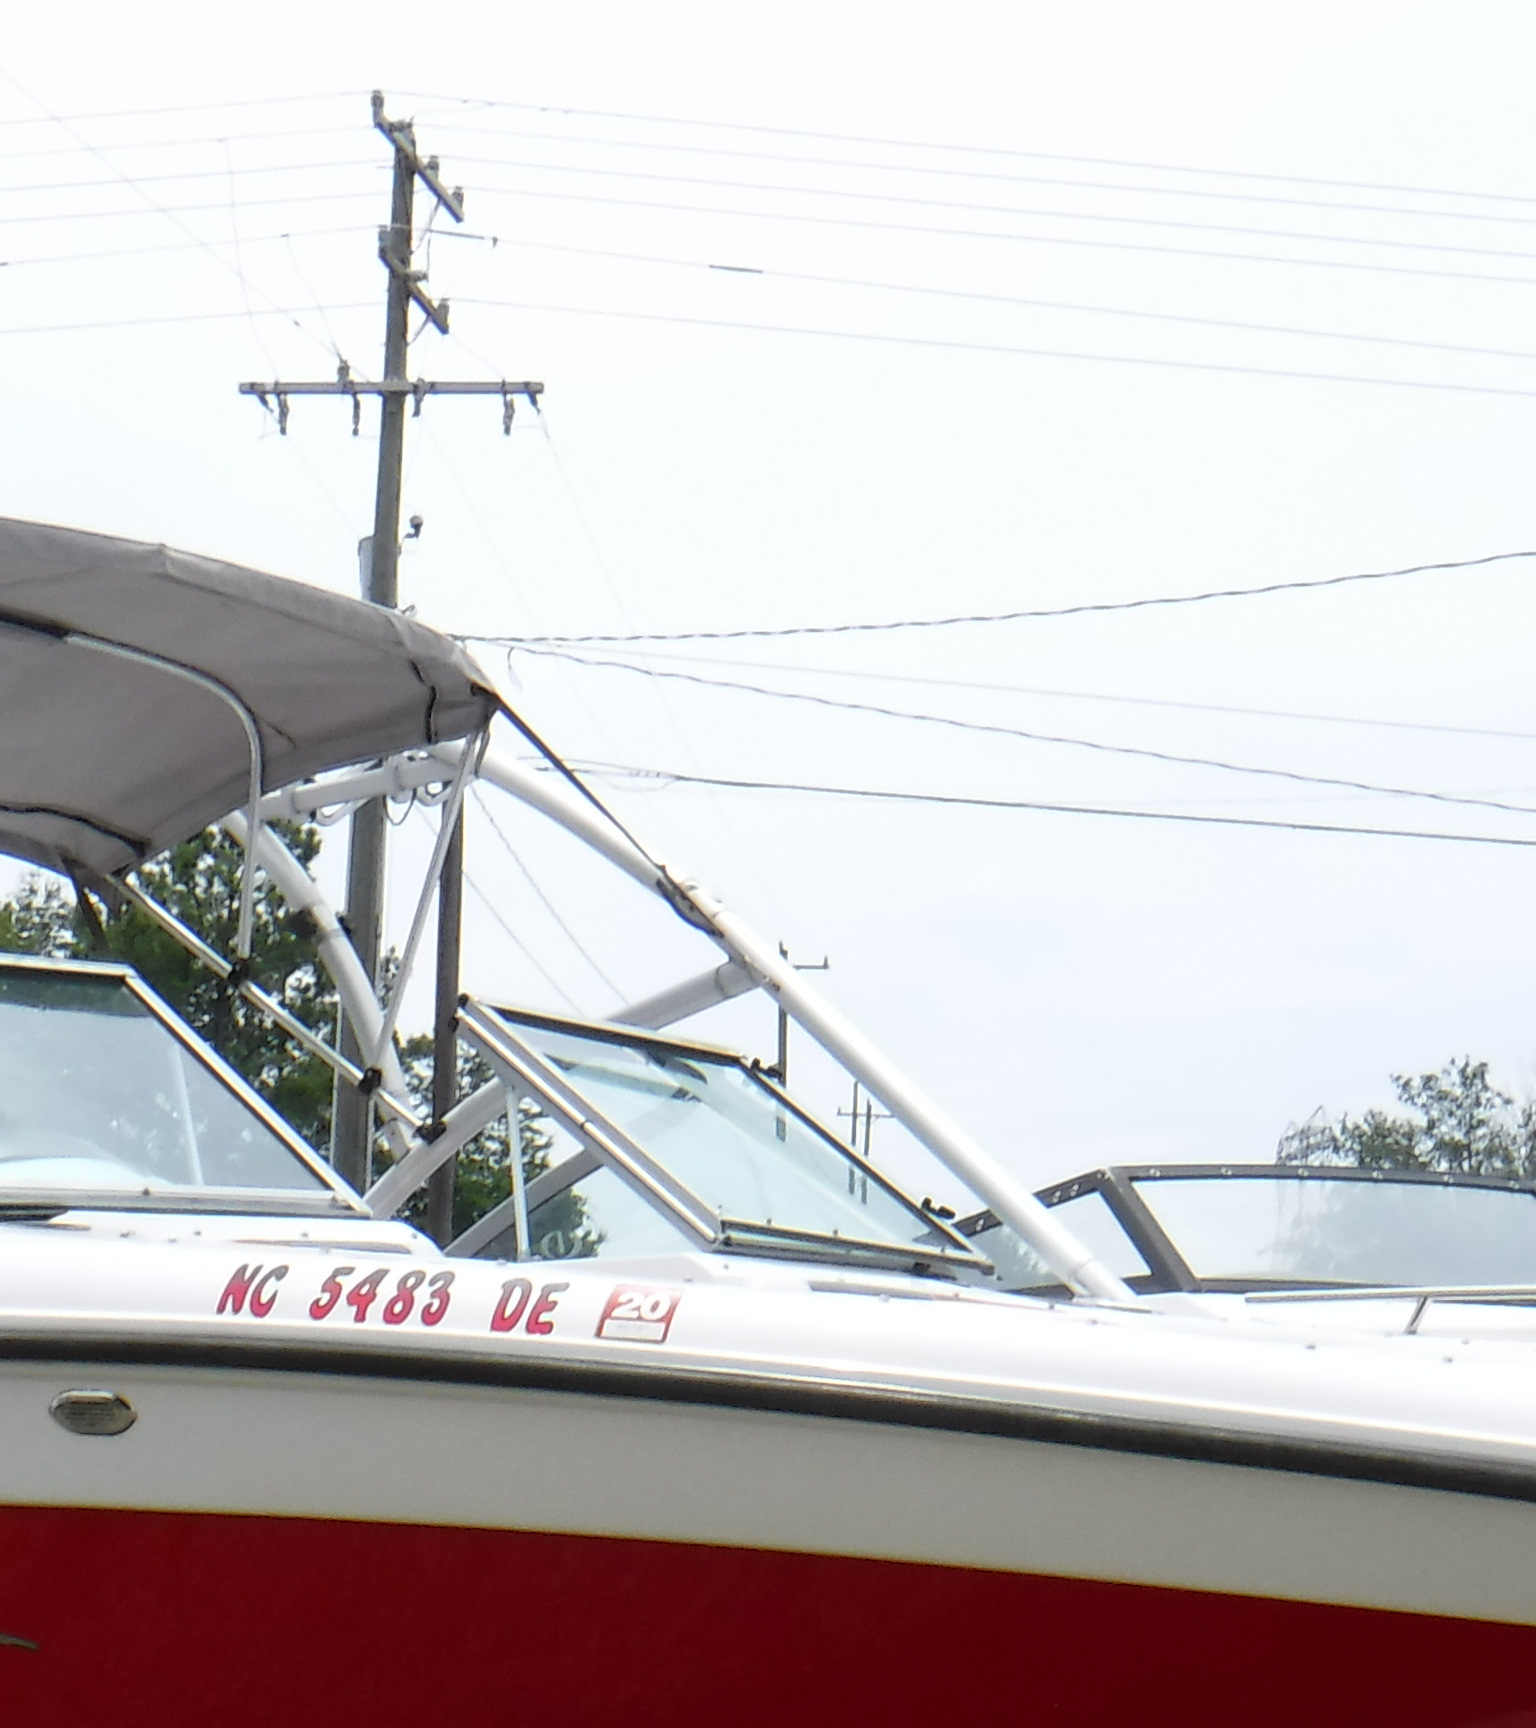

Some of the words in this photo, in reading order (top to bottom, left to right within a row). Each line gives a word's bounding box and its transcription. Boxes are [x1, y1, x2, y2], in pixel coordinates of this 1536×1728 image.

[216, 1263, 289, 1318] NC
[308, 1266, 456, 1327] 5483
[489, 1277, 570, 1336] DE
[609, 1291, 671, 1321] 20
